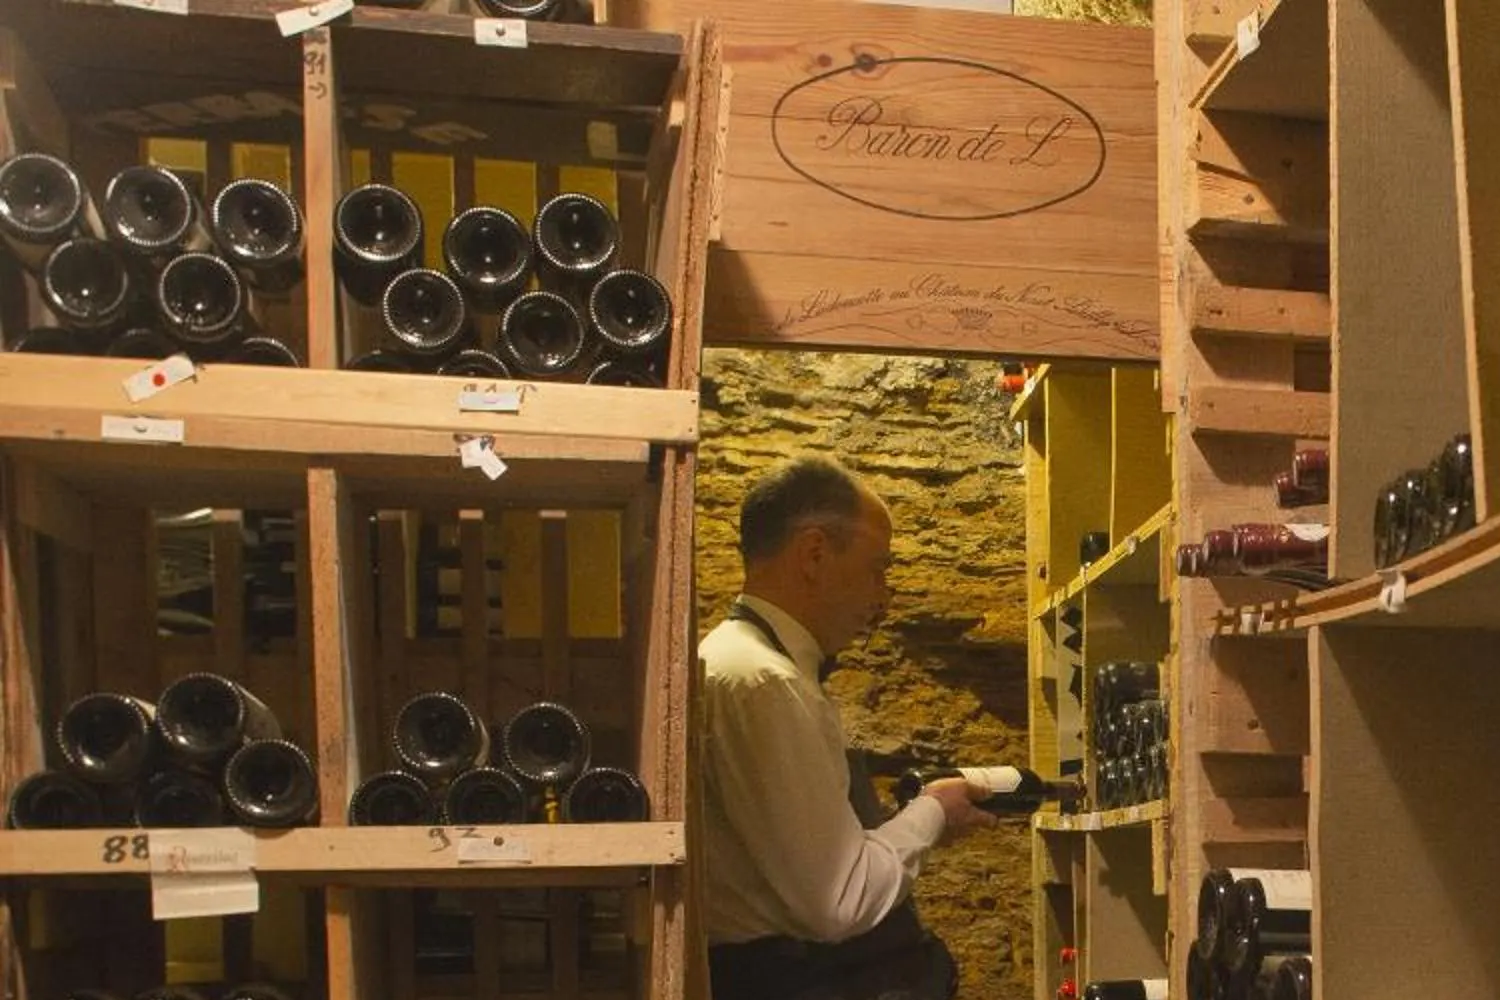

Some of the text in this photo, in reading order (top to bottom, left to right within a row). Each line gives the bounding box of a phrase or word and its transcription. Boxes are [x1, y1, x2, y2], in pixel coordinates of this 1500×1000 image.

[815, 95, 1076, 167] Baron de L
[103, 833, 149, 864] 88
